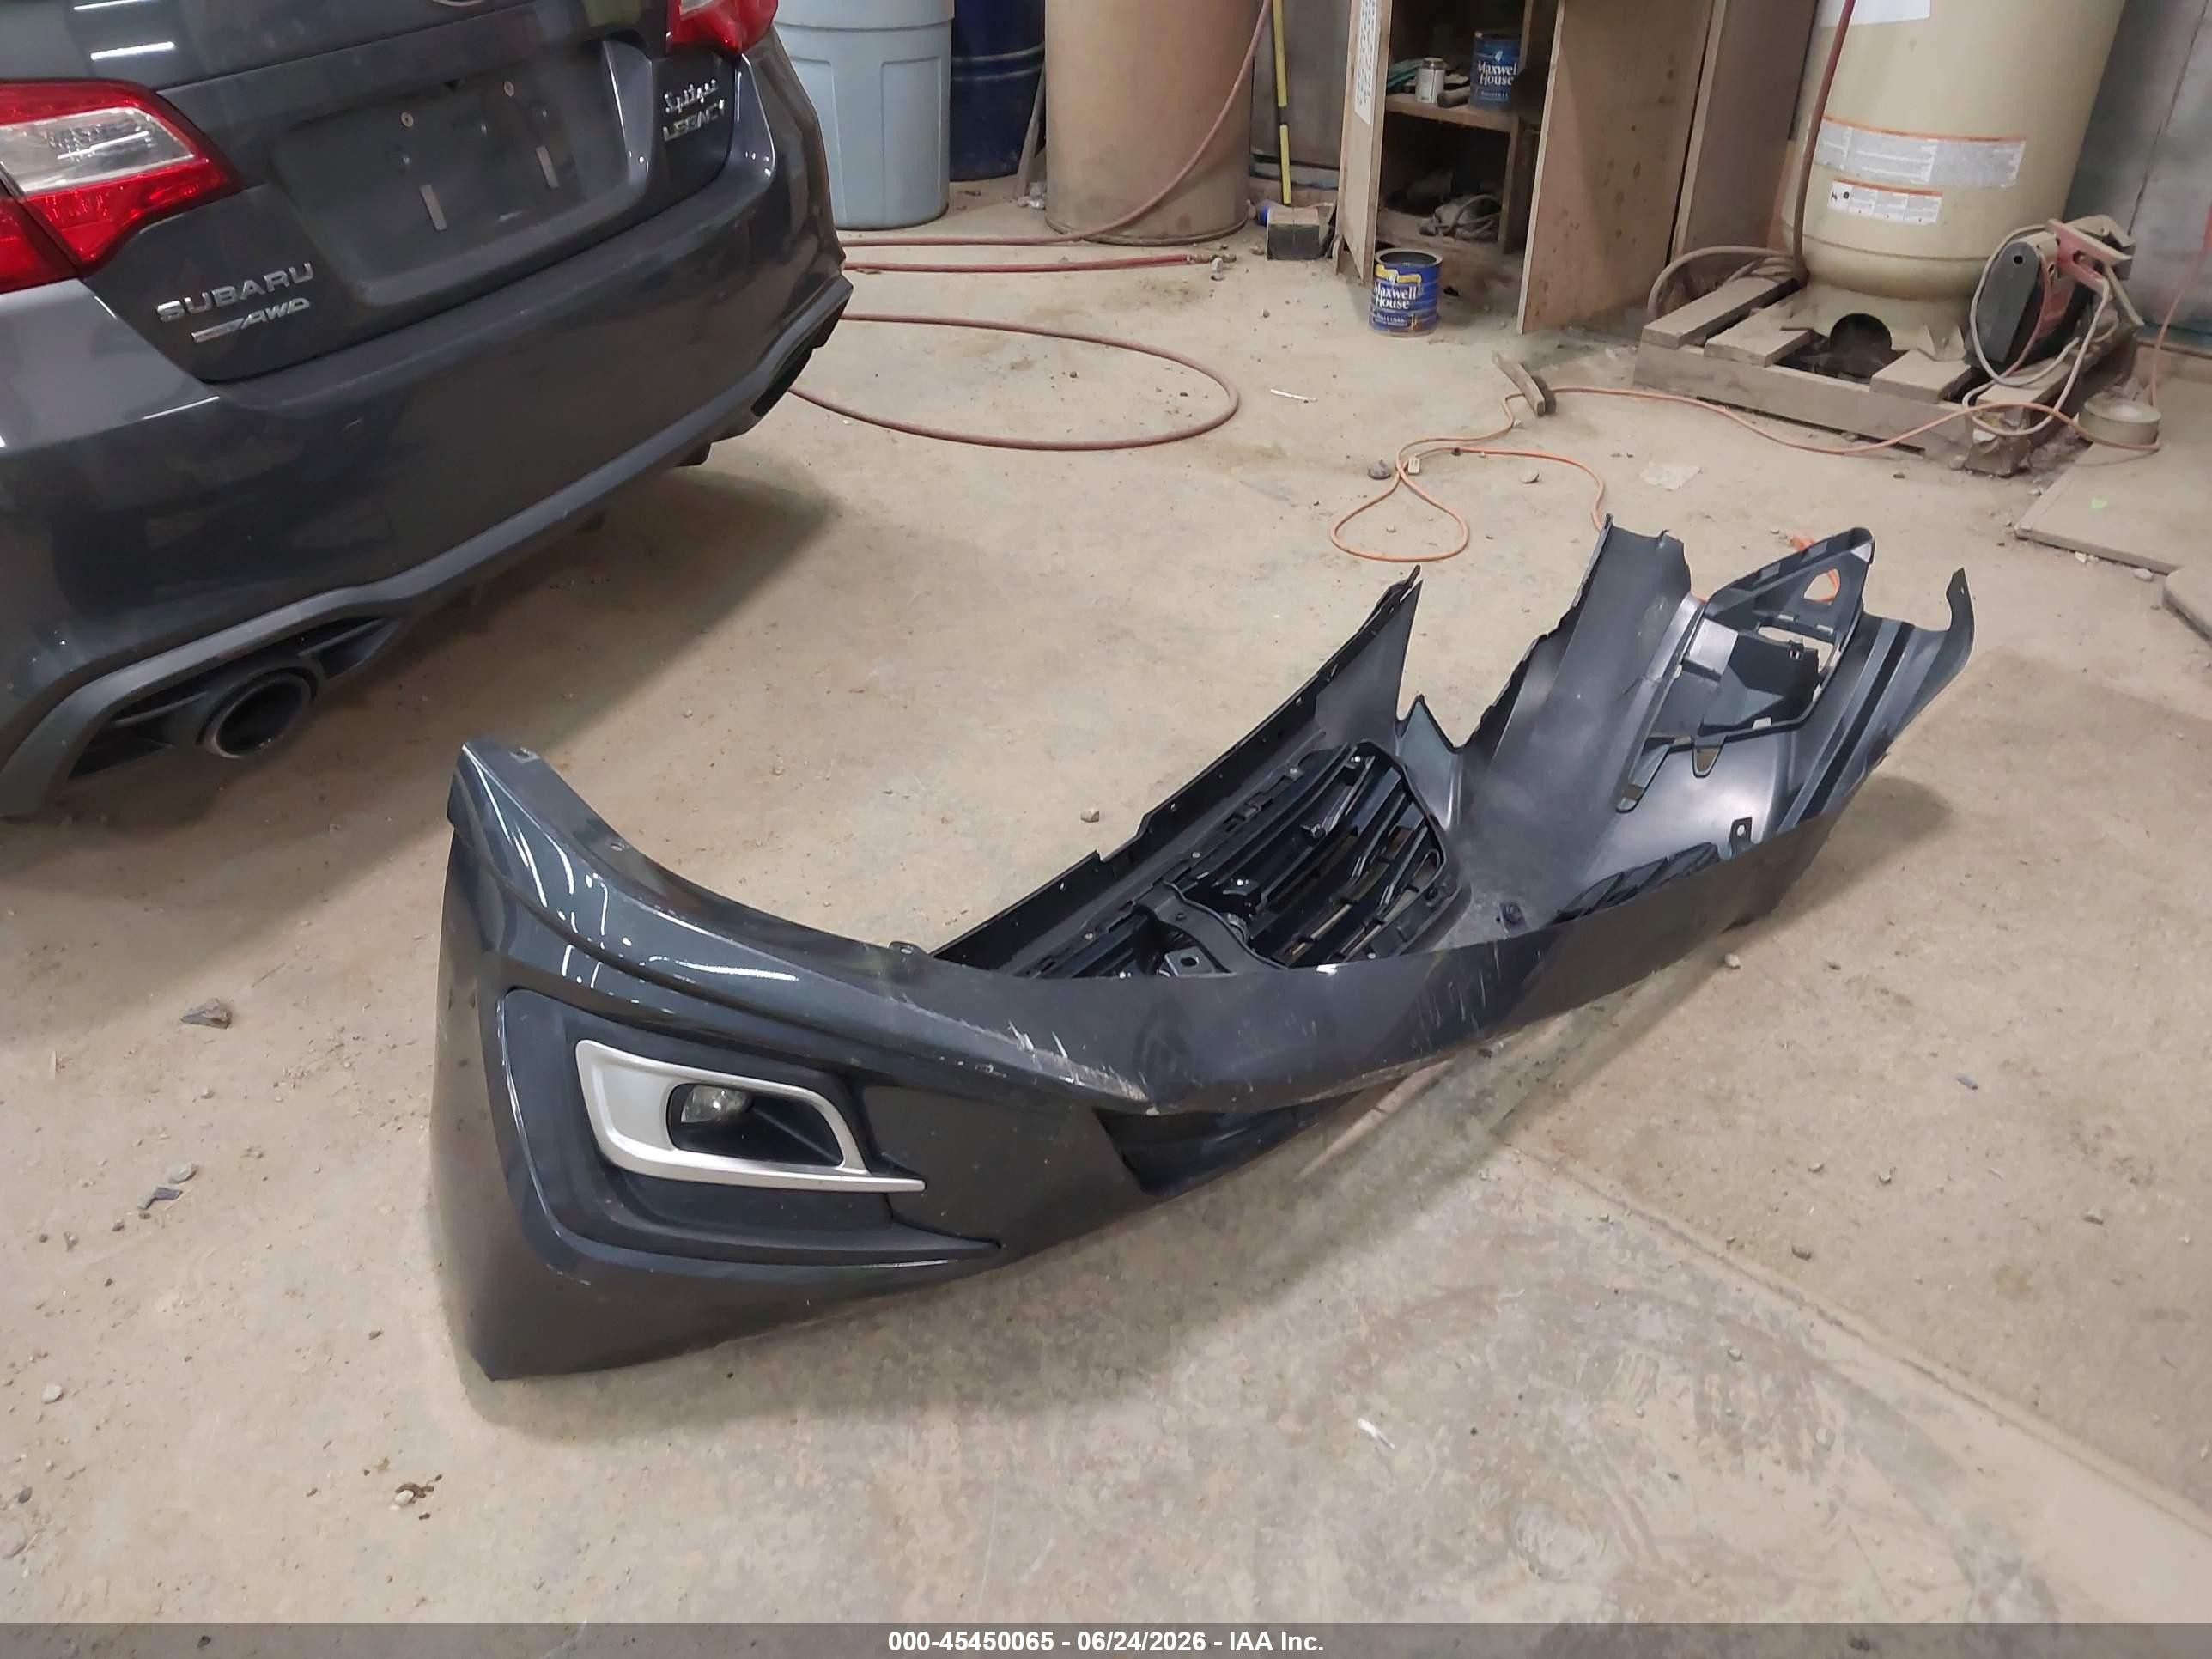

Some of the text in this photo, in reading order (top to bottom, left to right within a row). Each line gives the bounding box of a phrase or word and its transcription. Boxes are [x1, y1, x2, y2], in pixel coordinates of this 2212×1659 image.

[1477, 60, 1518, 76] Maxwel
[156, 262, 314, 323] SUBARU
[1376, 294, 1410, 310] House
[240, 297, 311, 330] AWD
